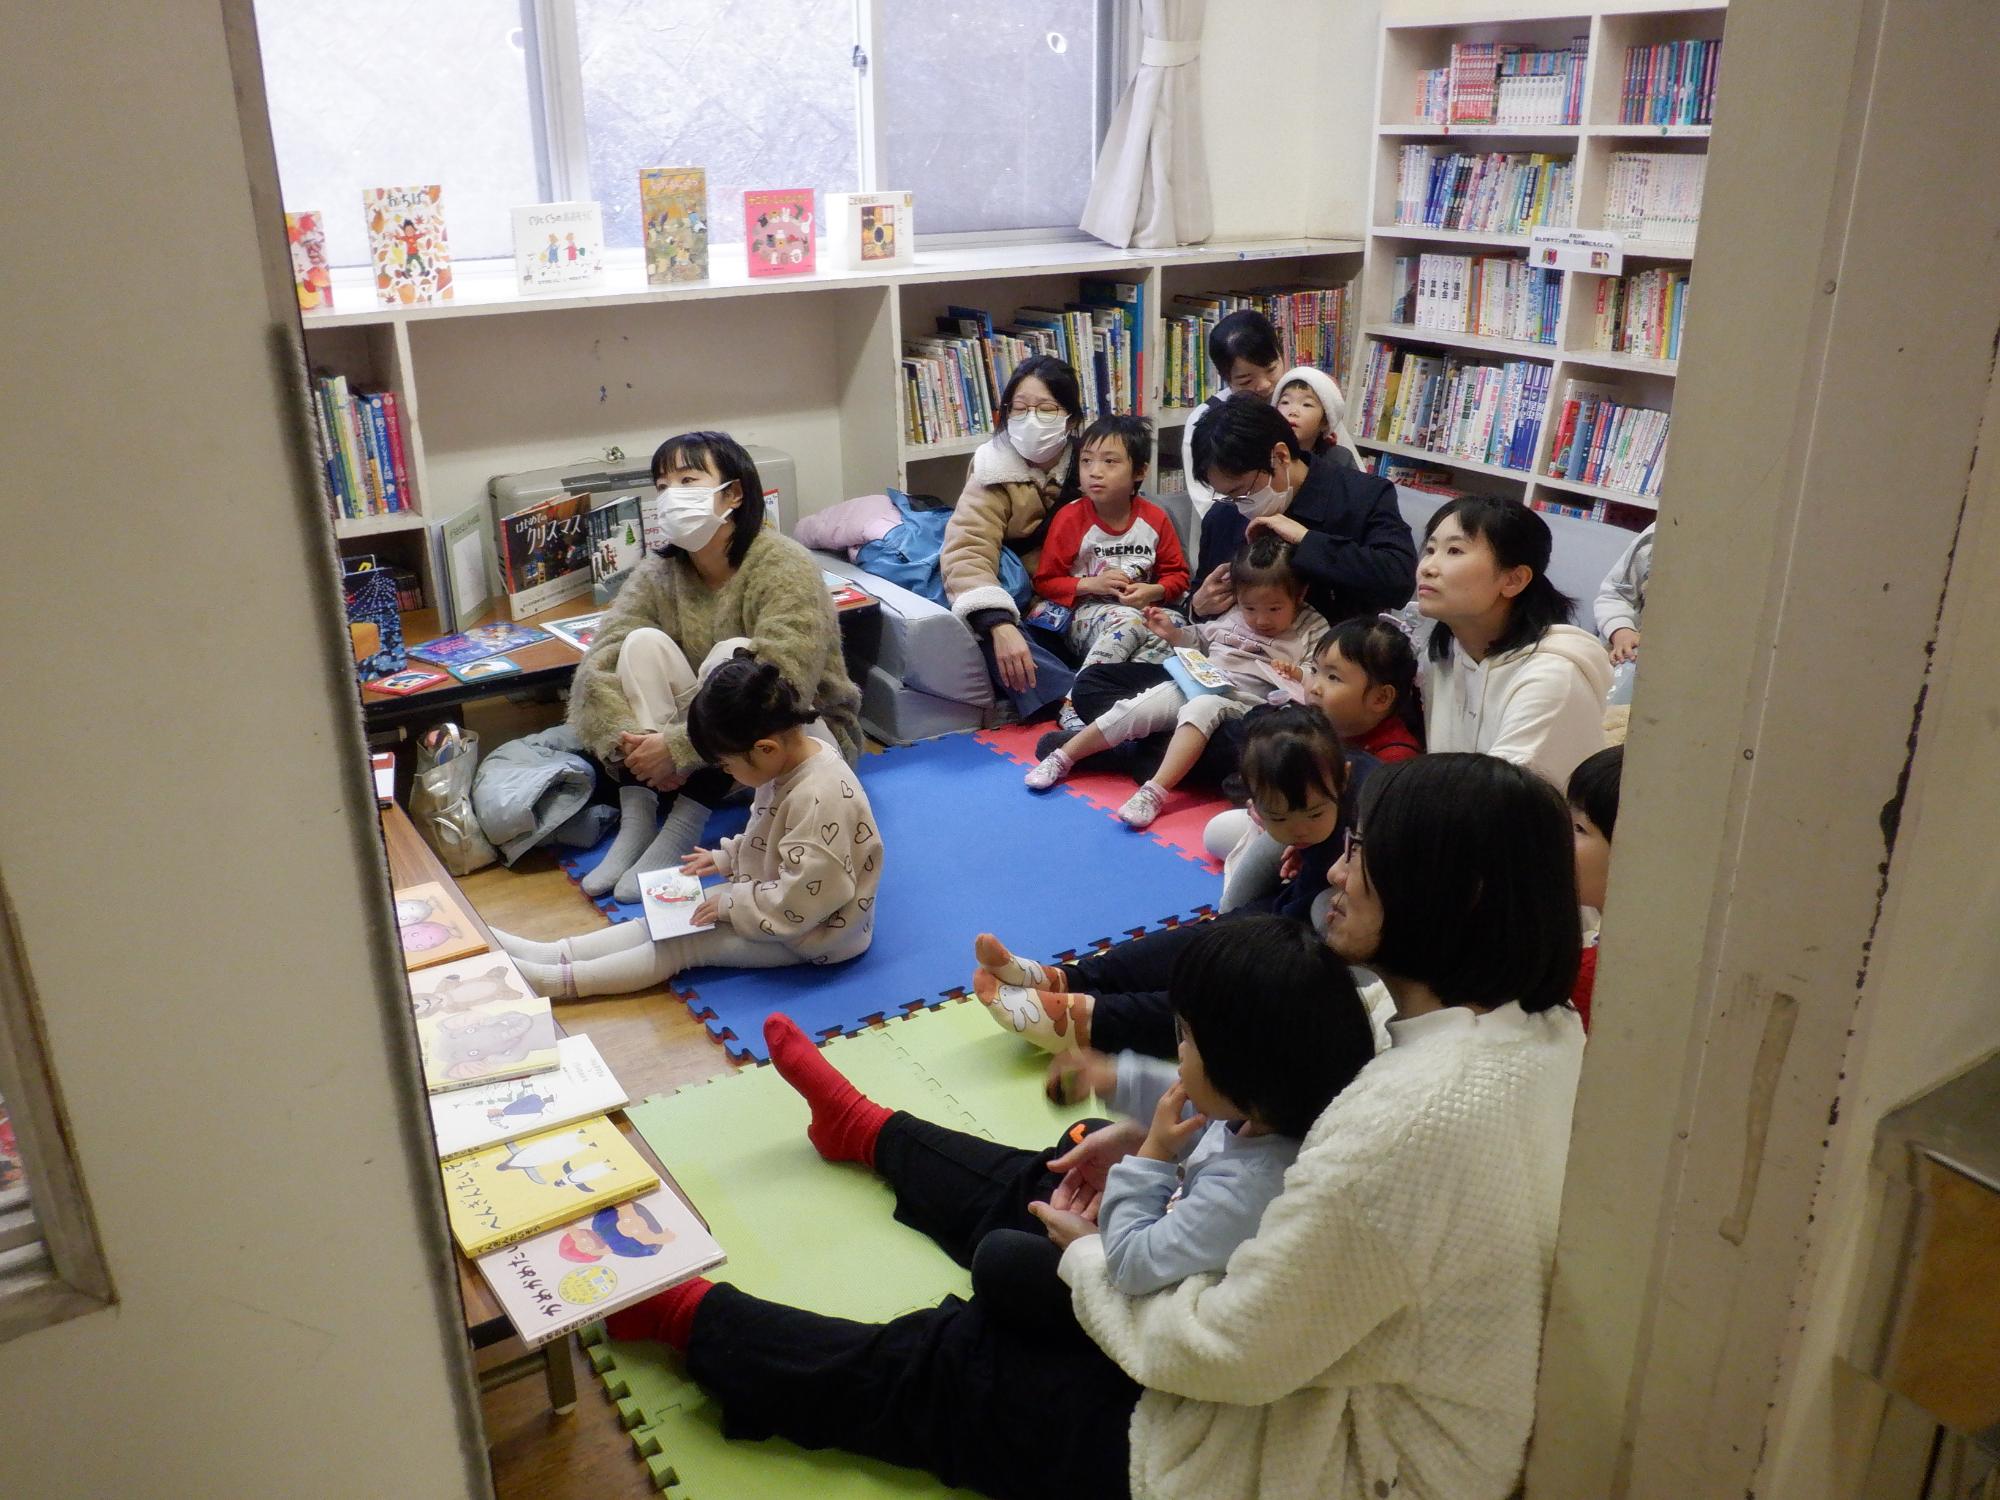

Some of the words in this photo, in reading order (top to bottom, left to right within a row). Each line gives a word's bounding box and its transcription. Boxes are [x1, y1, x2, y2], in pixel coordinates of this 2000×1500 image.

[527, 514, 581, 555] クリスマス
